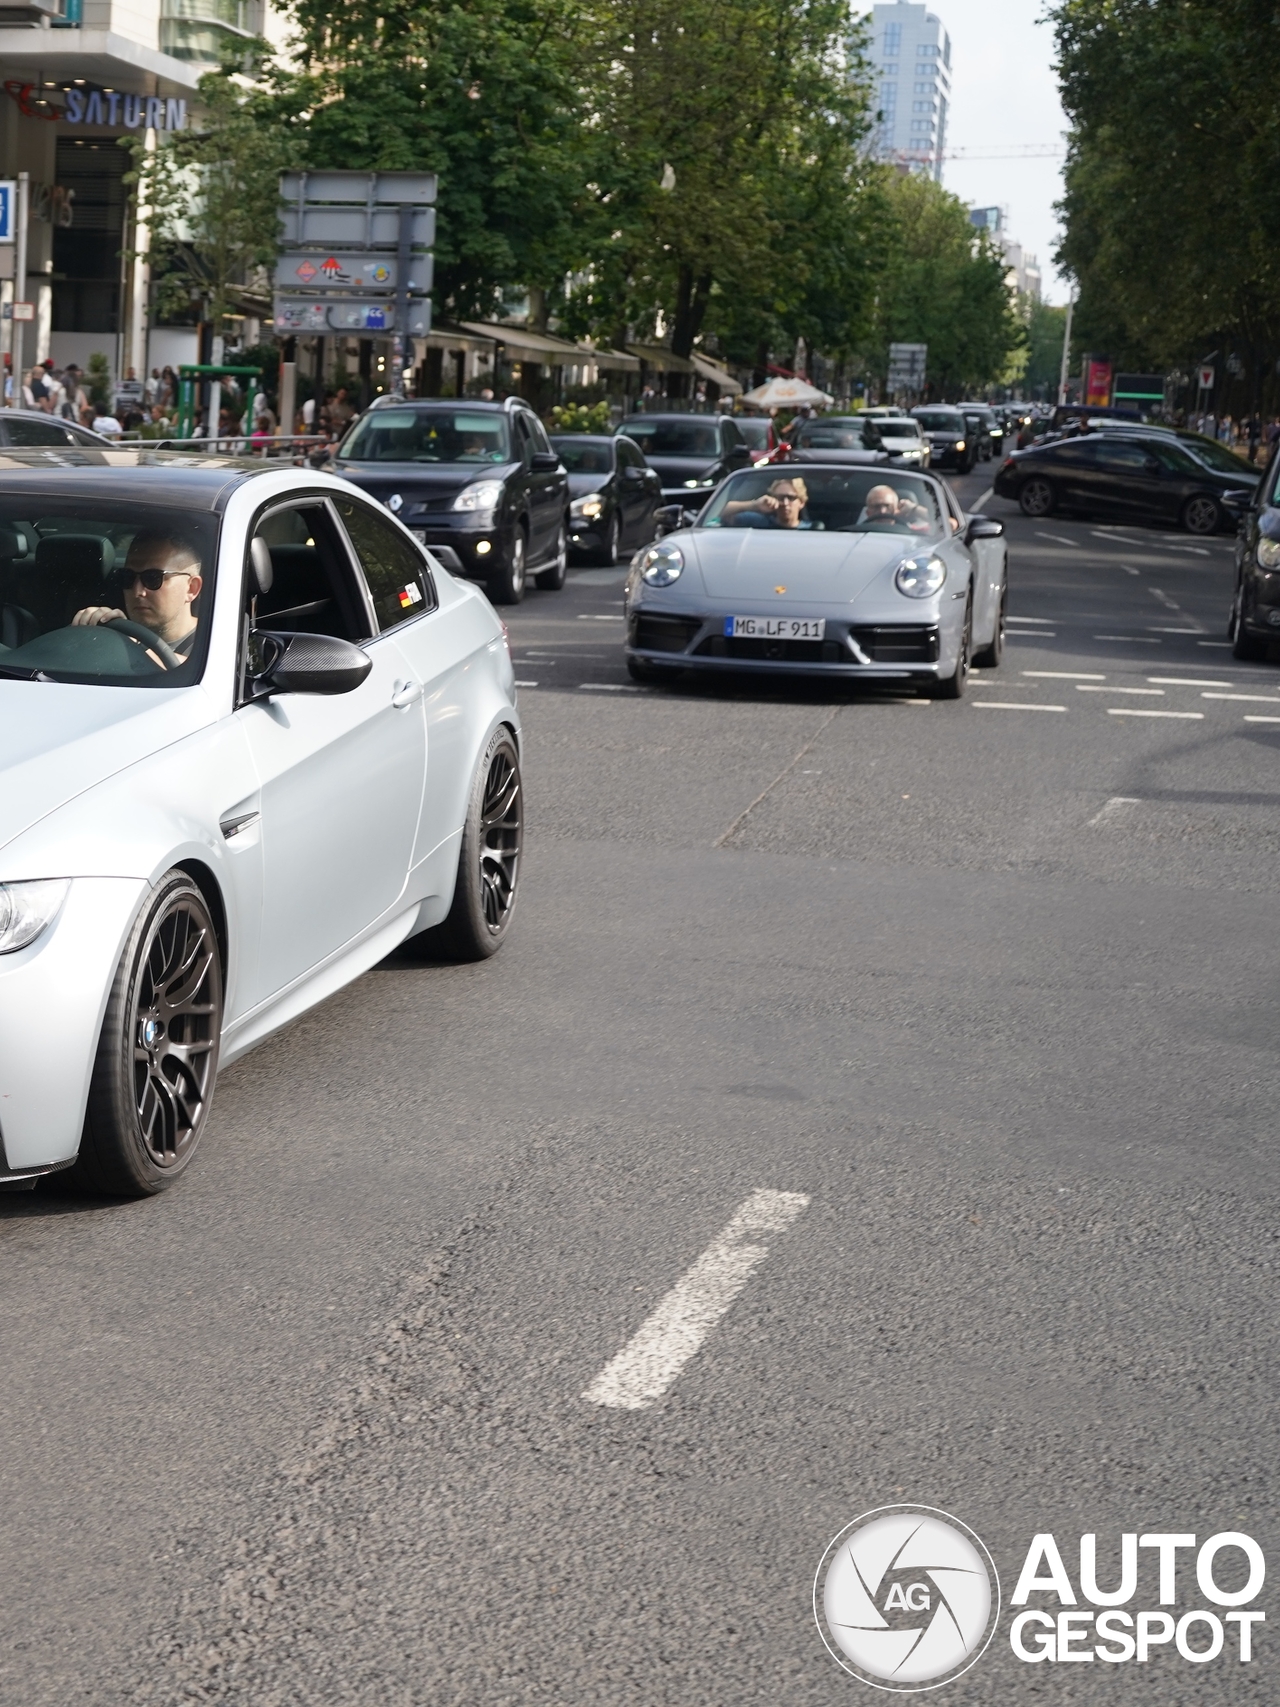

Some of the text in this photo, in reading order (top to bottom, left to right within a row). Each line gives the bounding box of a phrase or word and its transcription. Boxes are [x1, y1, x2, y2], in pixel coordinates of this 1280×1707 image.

[65, 89, 186, 131] SATURN
[735, 619, 820, 637] MG LF 911
